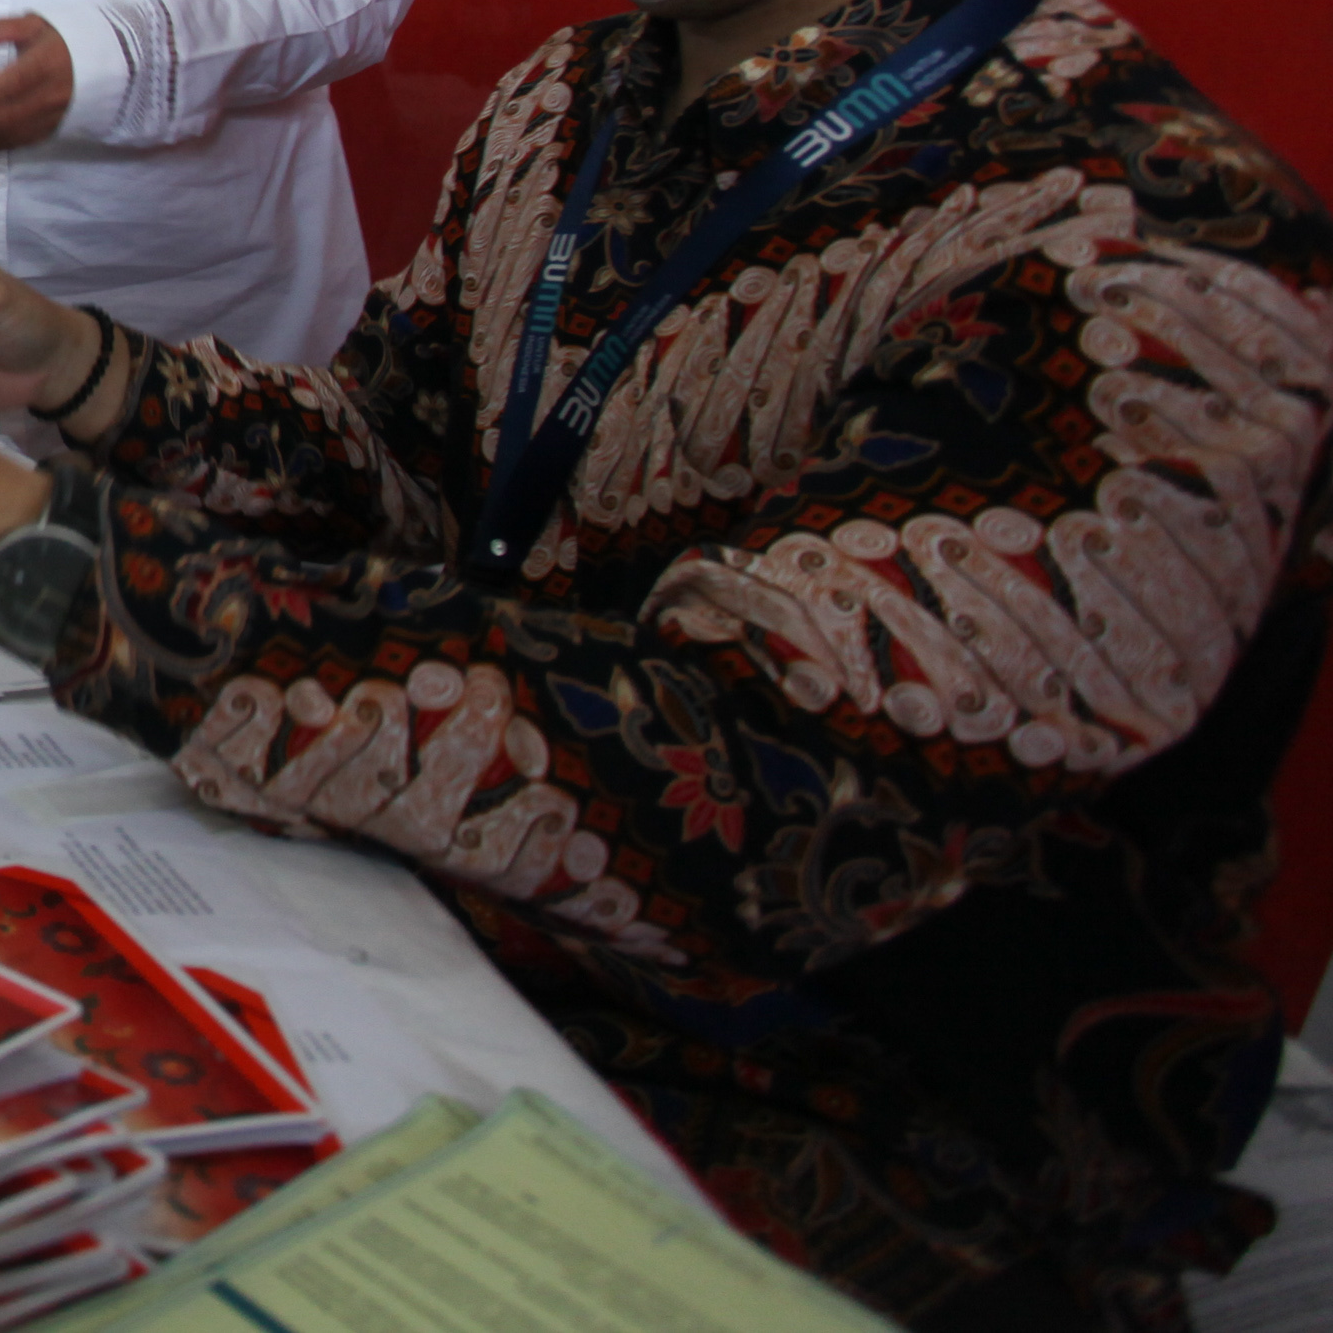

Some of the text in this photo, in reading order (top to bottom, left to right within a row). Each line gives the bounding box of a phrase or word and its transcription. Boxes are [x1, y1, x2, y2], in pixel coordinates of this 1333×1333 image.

[783, 71, 914, 169] BUMN
[530, 233, 577, 333] BUMN
[558, 334, 629, 437] BUMN
